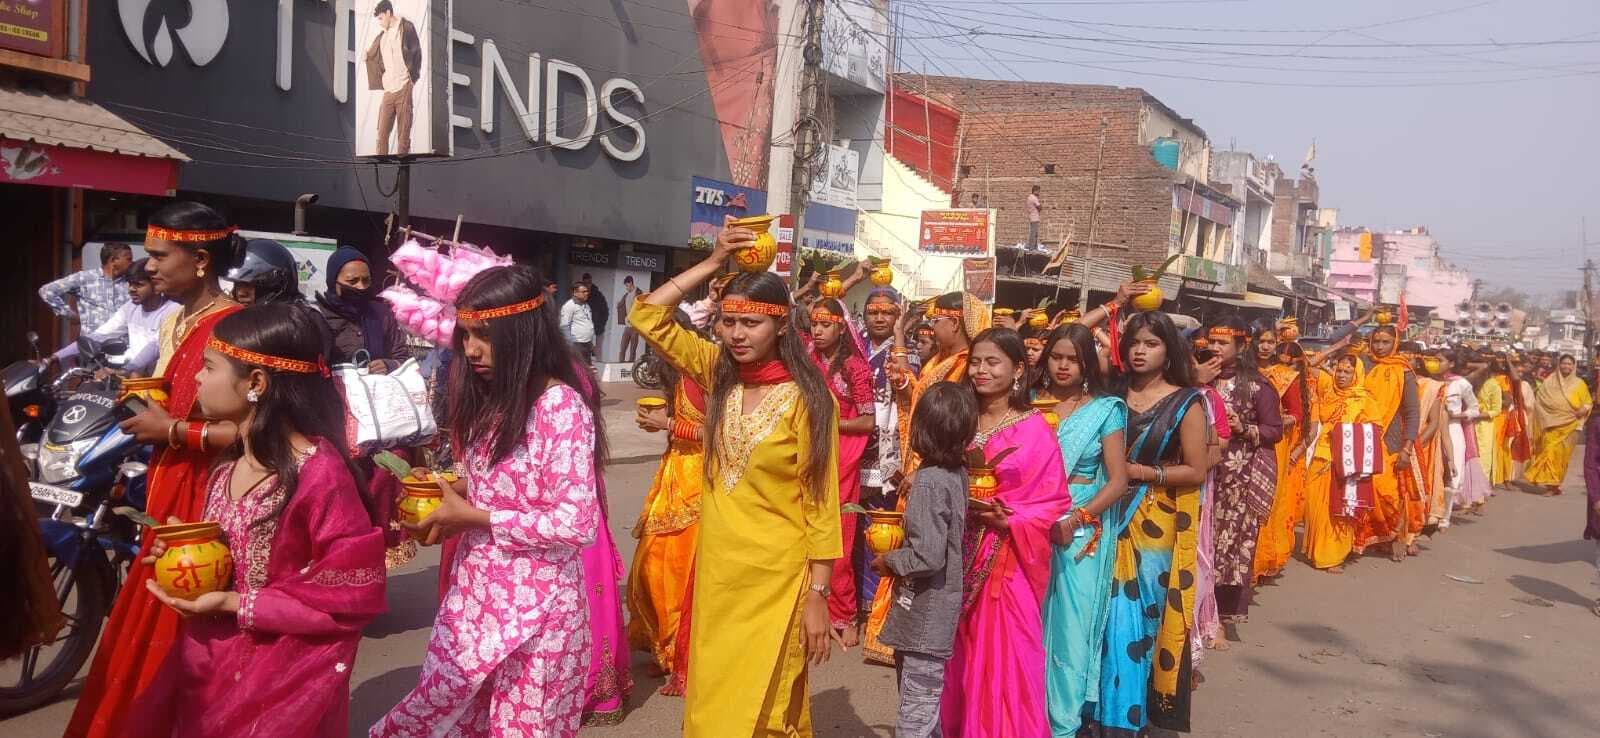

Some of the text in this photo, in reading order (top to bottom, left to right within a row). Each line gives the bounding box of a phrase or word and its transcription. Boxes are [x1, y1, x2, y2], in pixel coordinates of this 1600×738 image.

[276, 0, 646, 161] TENDS
[696, 186, 724, 206] TVS
[571, 252, 608, 263] TRENDS
[625, 255, 657, 268] TRENDS
